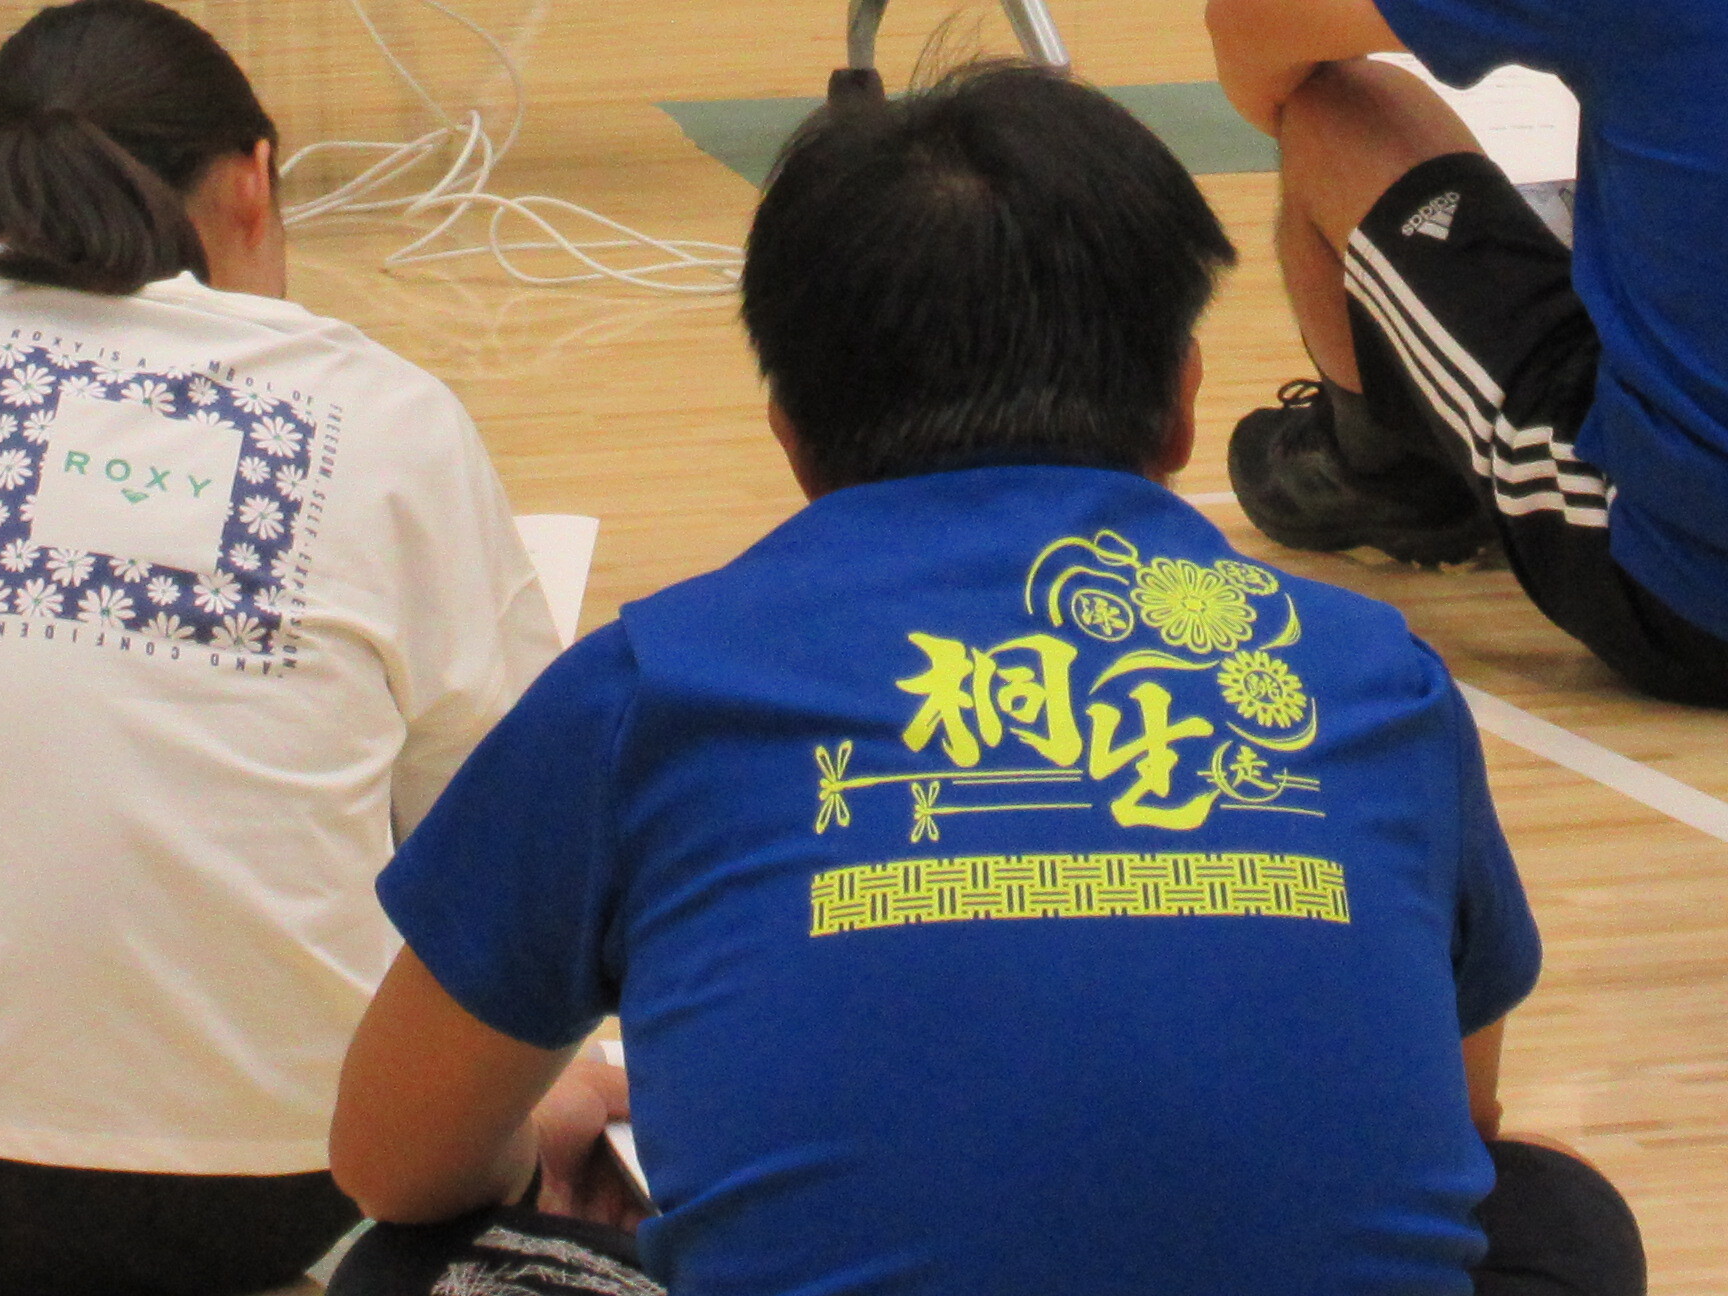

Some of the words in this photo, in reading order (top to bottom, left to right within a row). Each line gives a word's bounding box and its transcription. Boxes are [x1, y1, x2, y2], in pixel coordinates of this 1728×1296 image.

[10, 328, 85, 354] ROXY
[98, 347, 121, 362] IS
[63, 450, 213, 499] ROXY
[210, 652, 271, 675] AND
[896, 632, 1214, 831] 桐生
[1229, 744, 1277, 790] 走
